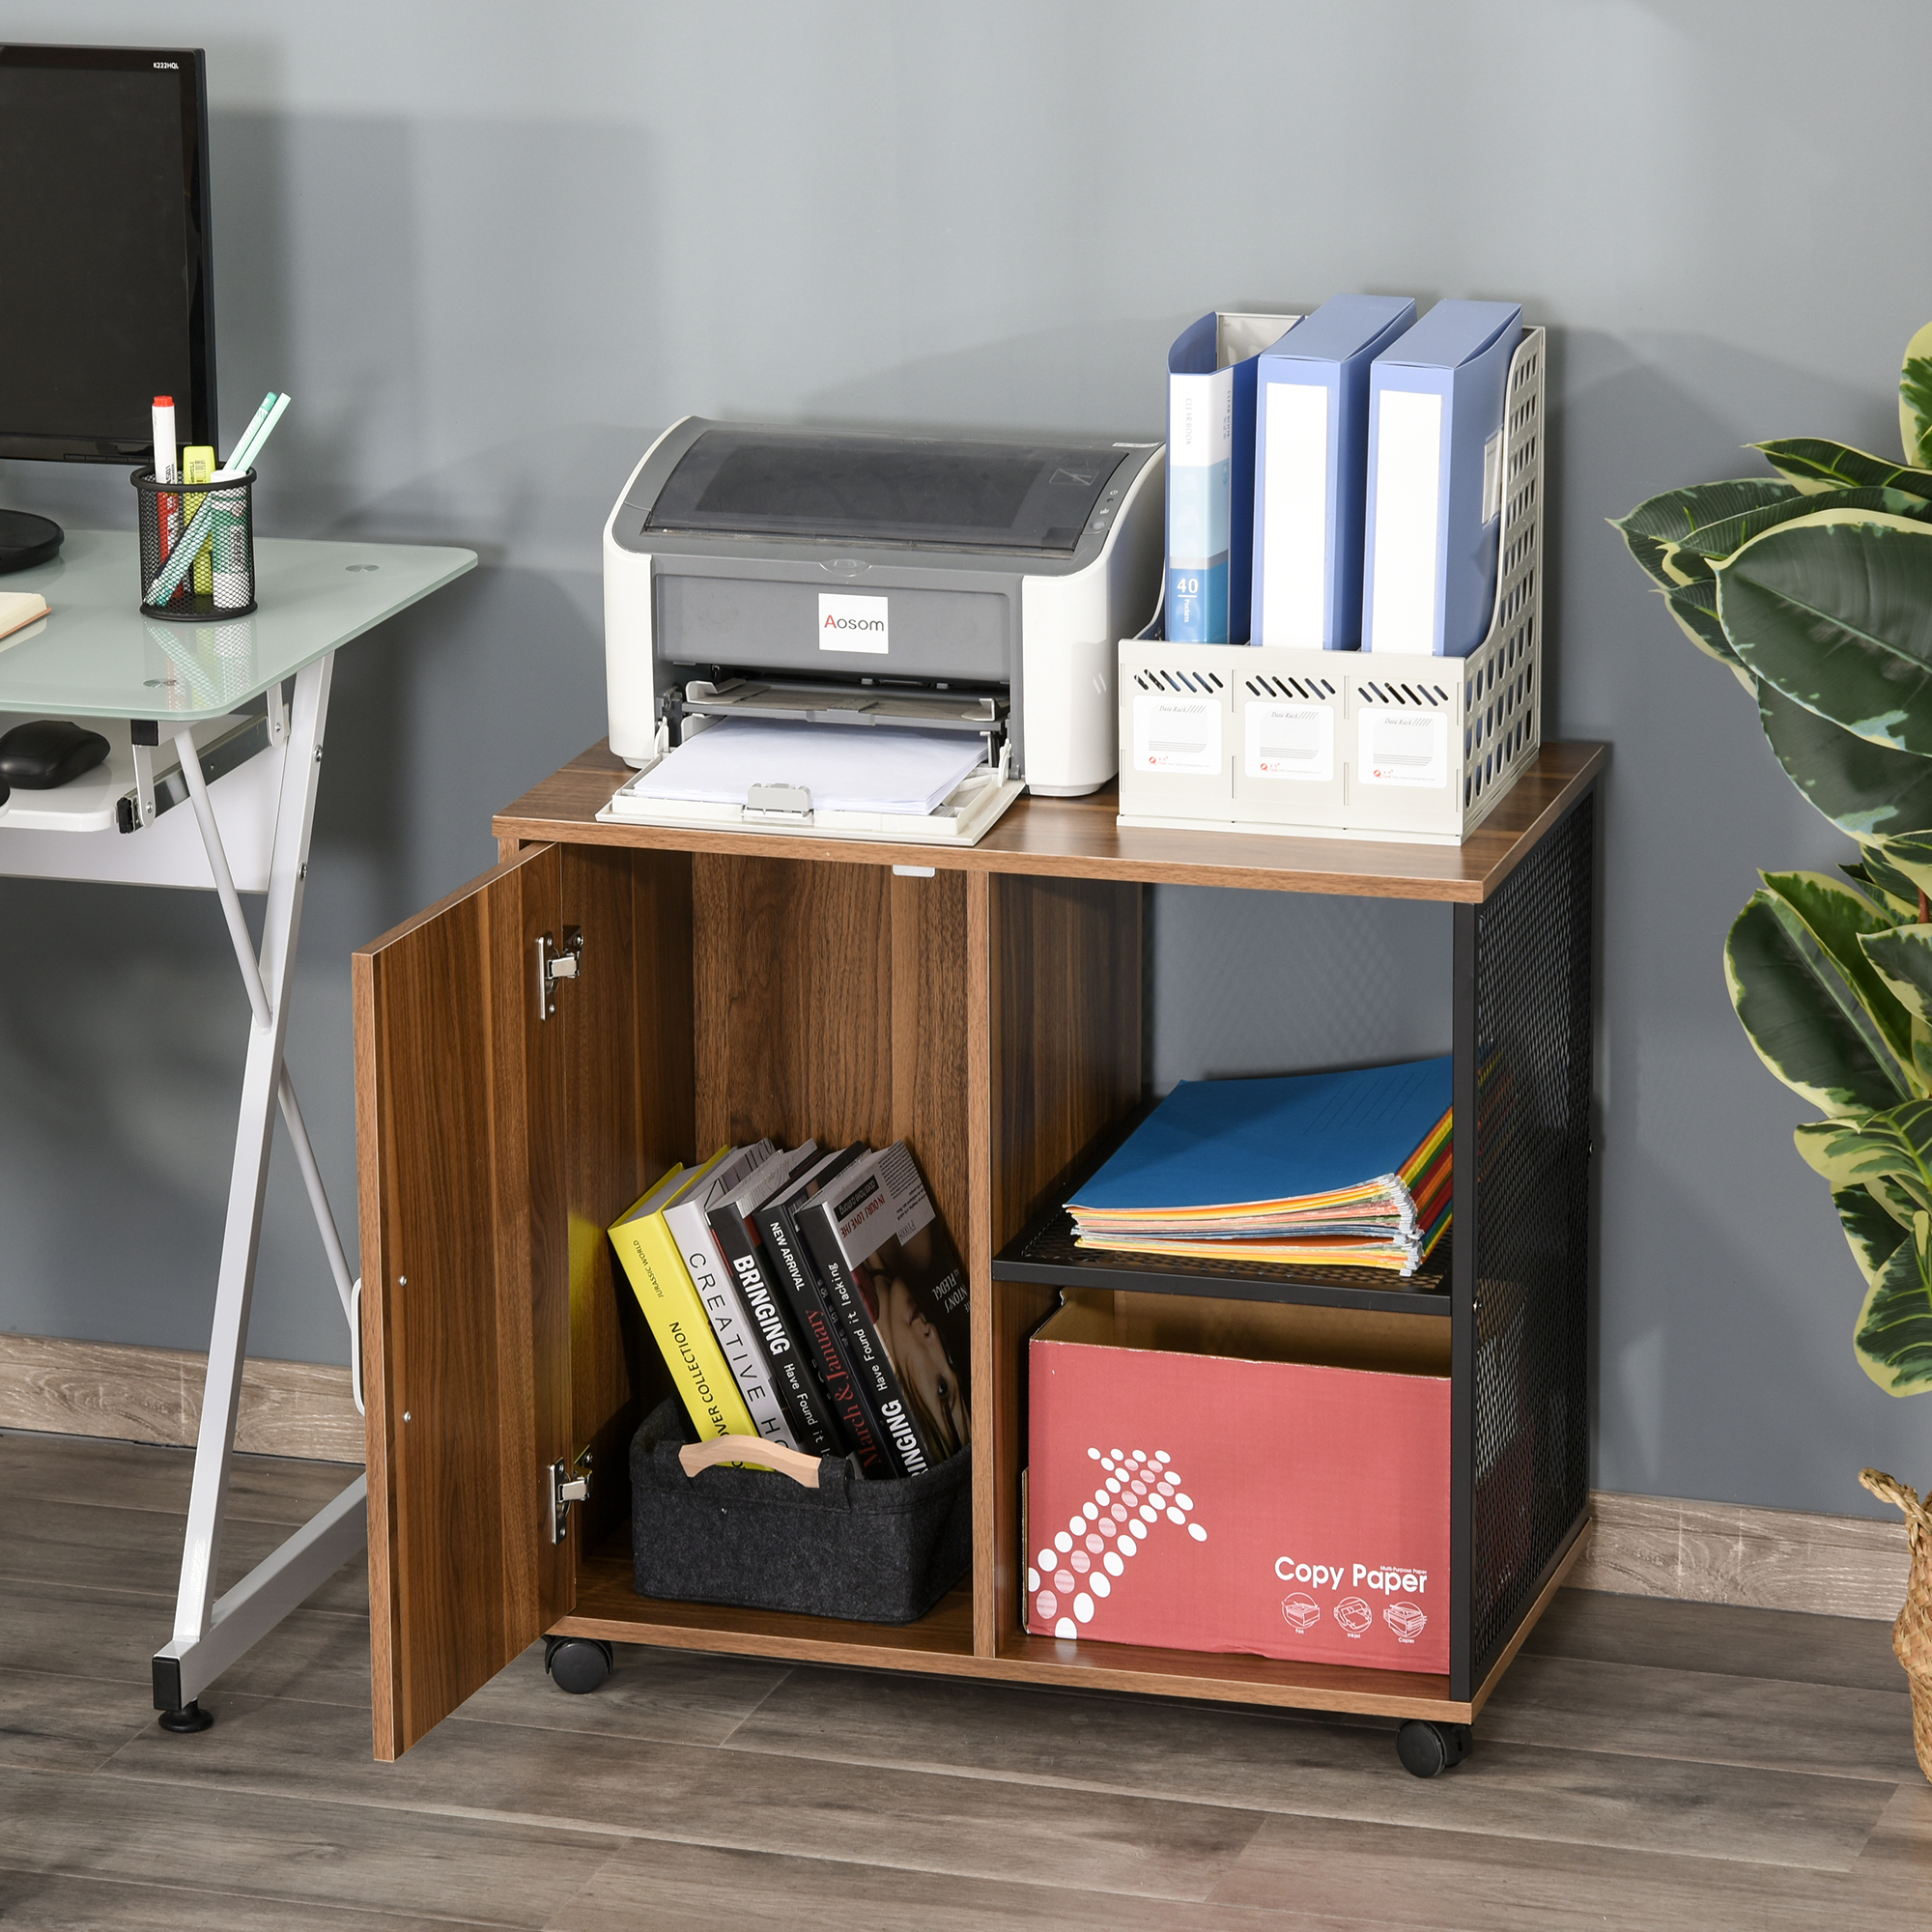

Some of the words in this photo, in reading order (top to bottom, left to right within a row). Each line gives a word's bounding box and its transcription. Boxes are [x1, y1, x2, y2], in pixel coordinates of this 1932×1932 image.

[1177, 578, 1199, 594] 40
[824, 614, 885, 632] Aosom
[633, 1239, 649, 1266] WORLD
[770, 1221, 787, 1246] NEW
[781, 1247, 806, 1292] ARRIVAL
[644, 1265, 665, 1298] JURASSIC
[828, 1263, 851, 1307] lacking
[689, 1253, 766, 1402] CREATIVE
[847, 1311, 860, 1324] it
[668, 1321, 714, 1404] COLLECTION
[732, 1254, 790, 1355] BRINGING
[783, 1363, 800, 1390] Have
[796, 1392, 818, 1426] Found
[812, 1430, 825, 1443] it
[805, 1309, 850, 1381] January
[853, 1328, 875, 1362] Found
[834, 1382, 854, 1402] &
[871, 1364, 888, 1392] Have
[843, 1404, 882, 1468] March
[1274, 1555, 1345, 1591] Copy
[1352, 1563, 1428, 1596] Paper
